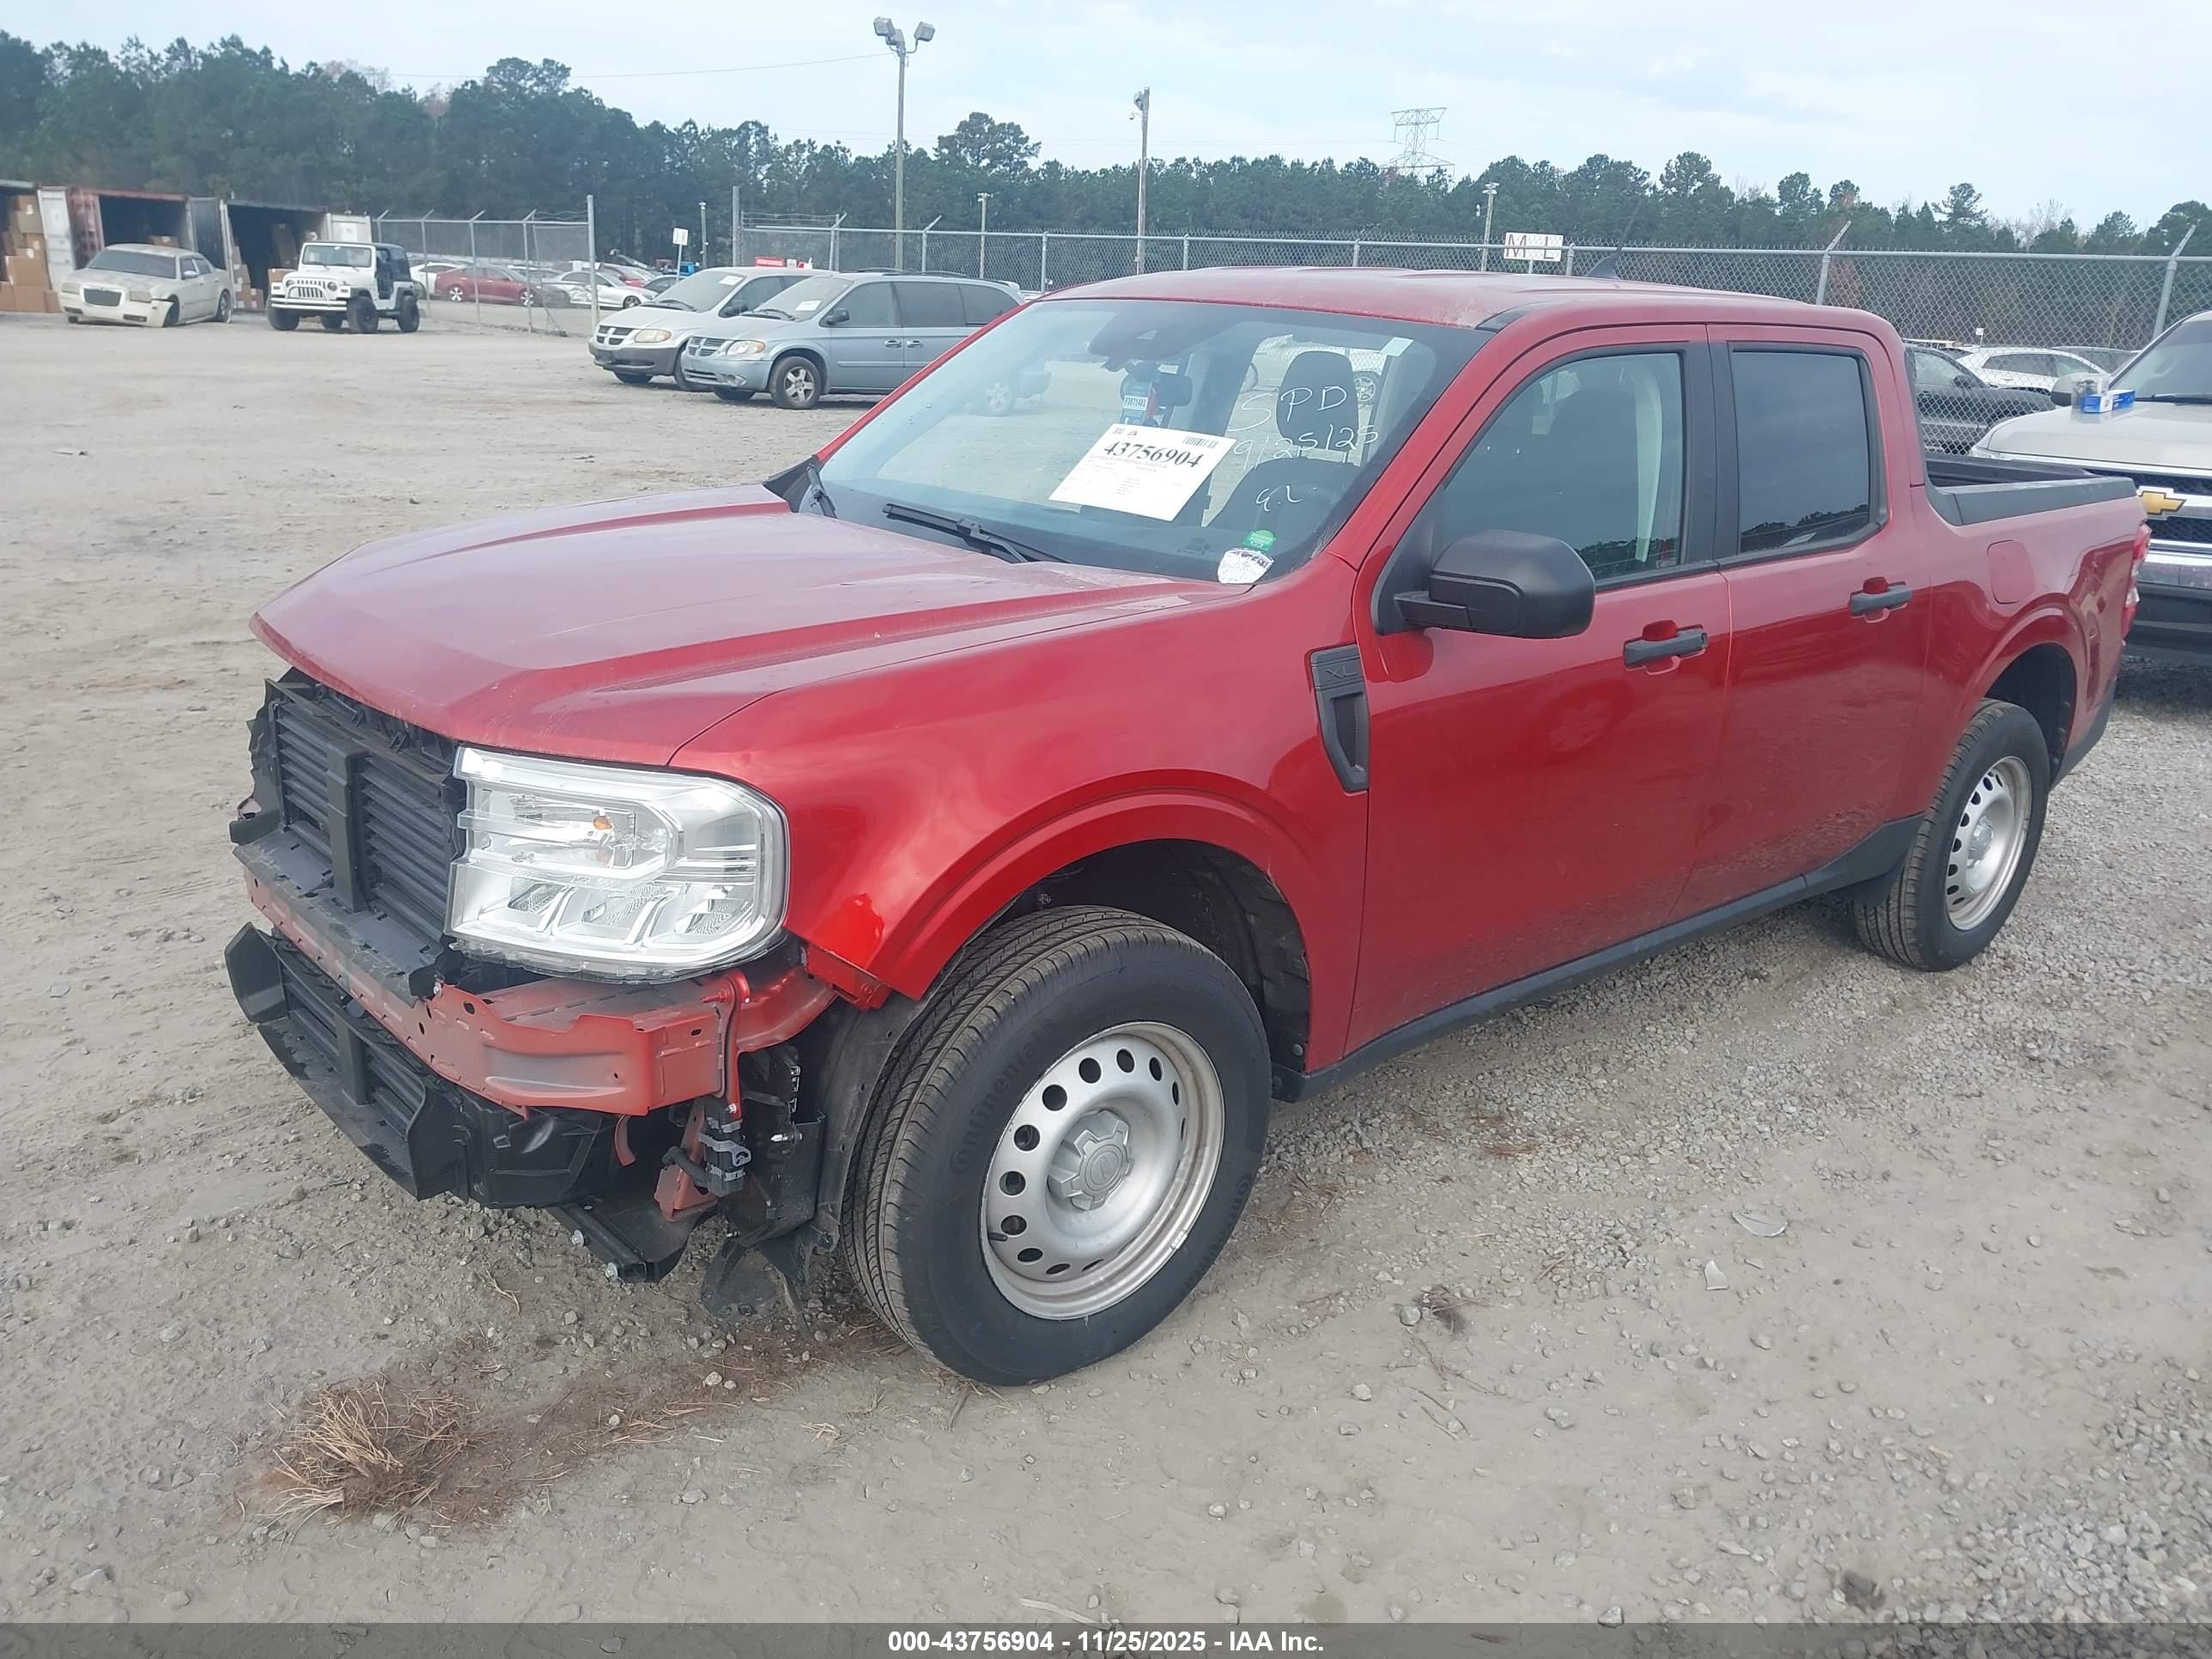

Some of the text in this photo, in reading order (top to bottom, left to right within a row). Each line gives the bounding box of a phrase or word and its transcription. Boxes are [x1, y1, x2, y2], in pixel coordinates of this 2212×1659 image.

[1103, 441, 1204, 468] 43756904
[1233, 423, 1379, 471] 9/25/25
[1327, 665, 1358, 679] XL
